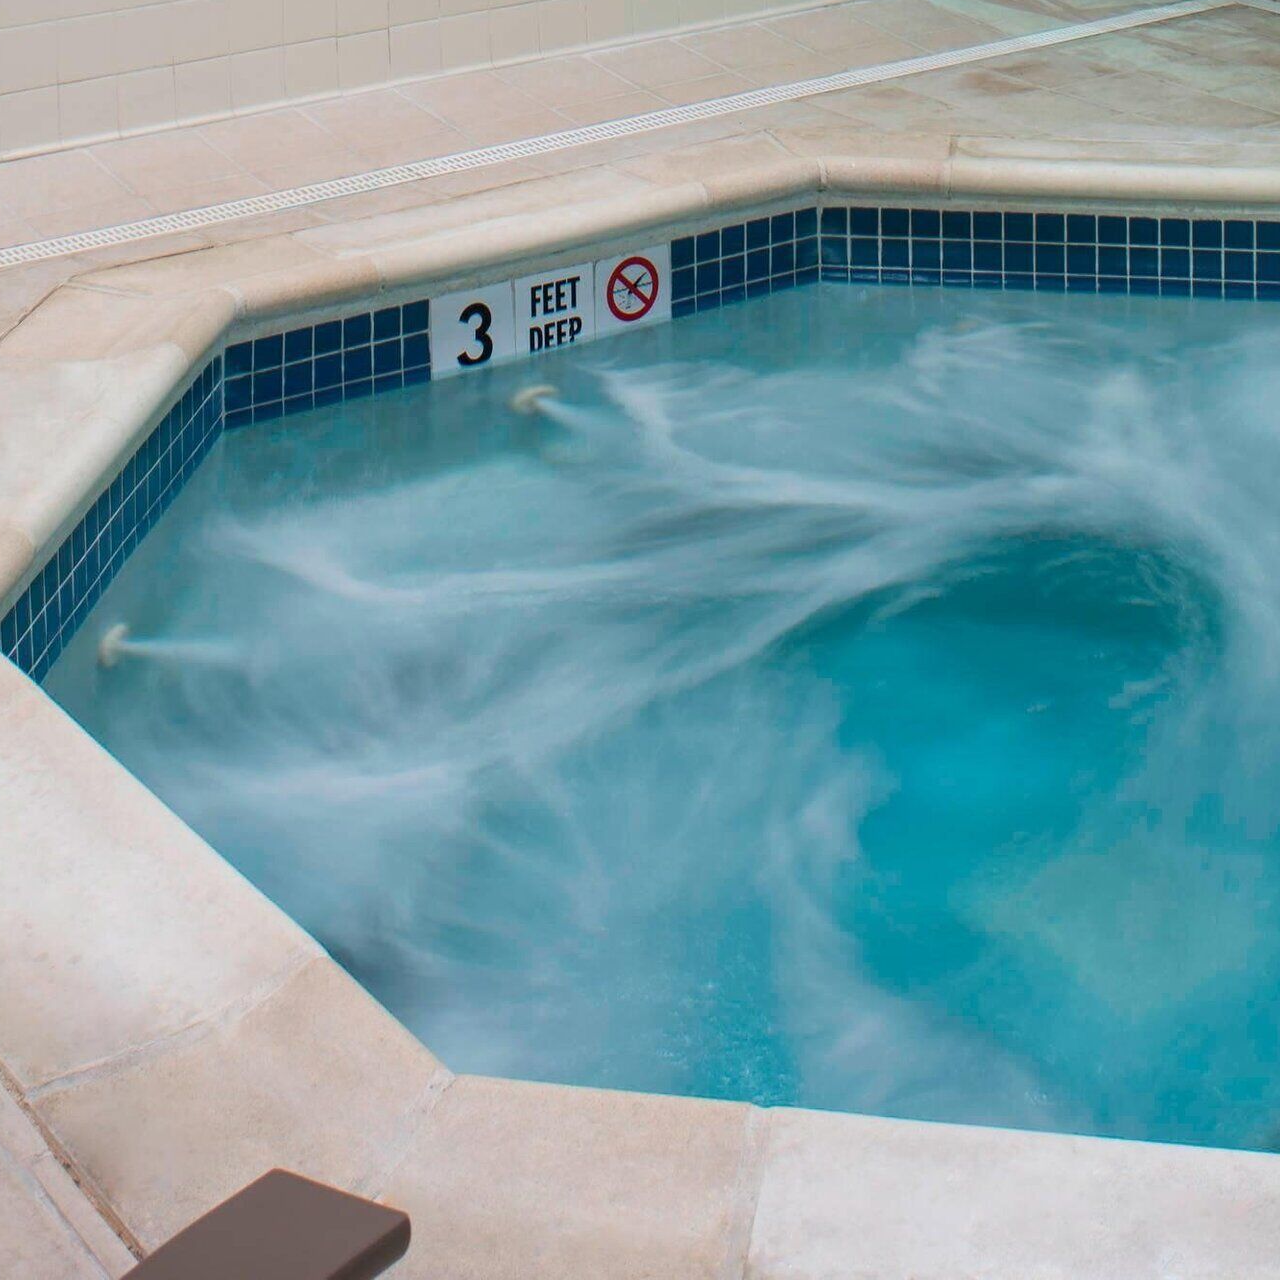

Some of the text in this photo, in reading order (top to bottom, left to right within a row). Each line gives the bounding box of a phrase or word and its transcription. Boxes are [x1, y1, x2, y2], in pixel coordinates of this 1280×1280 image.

[530, 275, 581, 318] FEET
[456, 301, 494, 367] 3
[529, 316, 583, 355] DEEP
